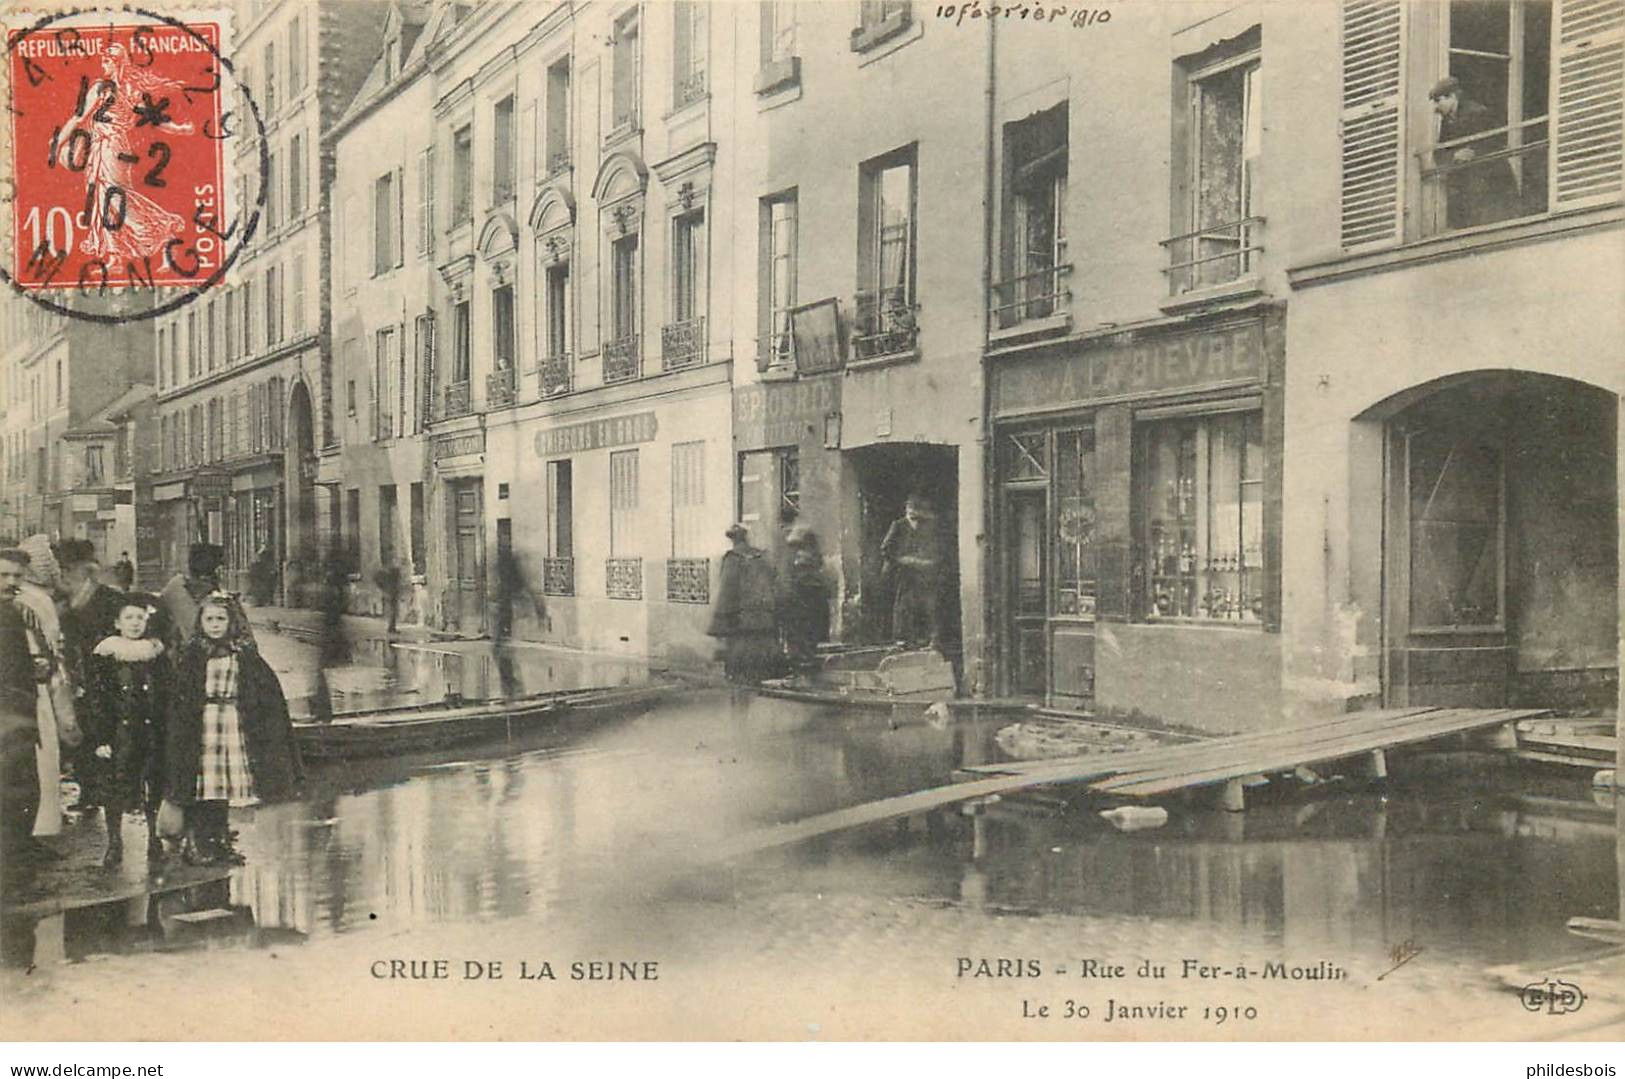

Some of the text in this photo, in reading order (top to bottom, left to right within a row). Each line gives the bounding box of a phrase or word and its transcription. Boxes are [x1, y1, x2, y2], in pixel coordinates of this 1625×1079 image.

[936, 5, 955, 19] 10
[1070, 9, 1111, 28] 1910
[74, 75, 117, 123] 12
[48, 126, 92, 173] 10
[83, 183, 127, 232] 10
